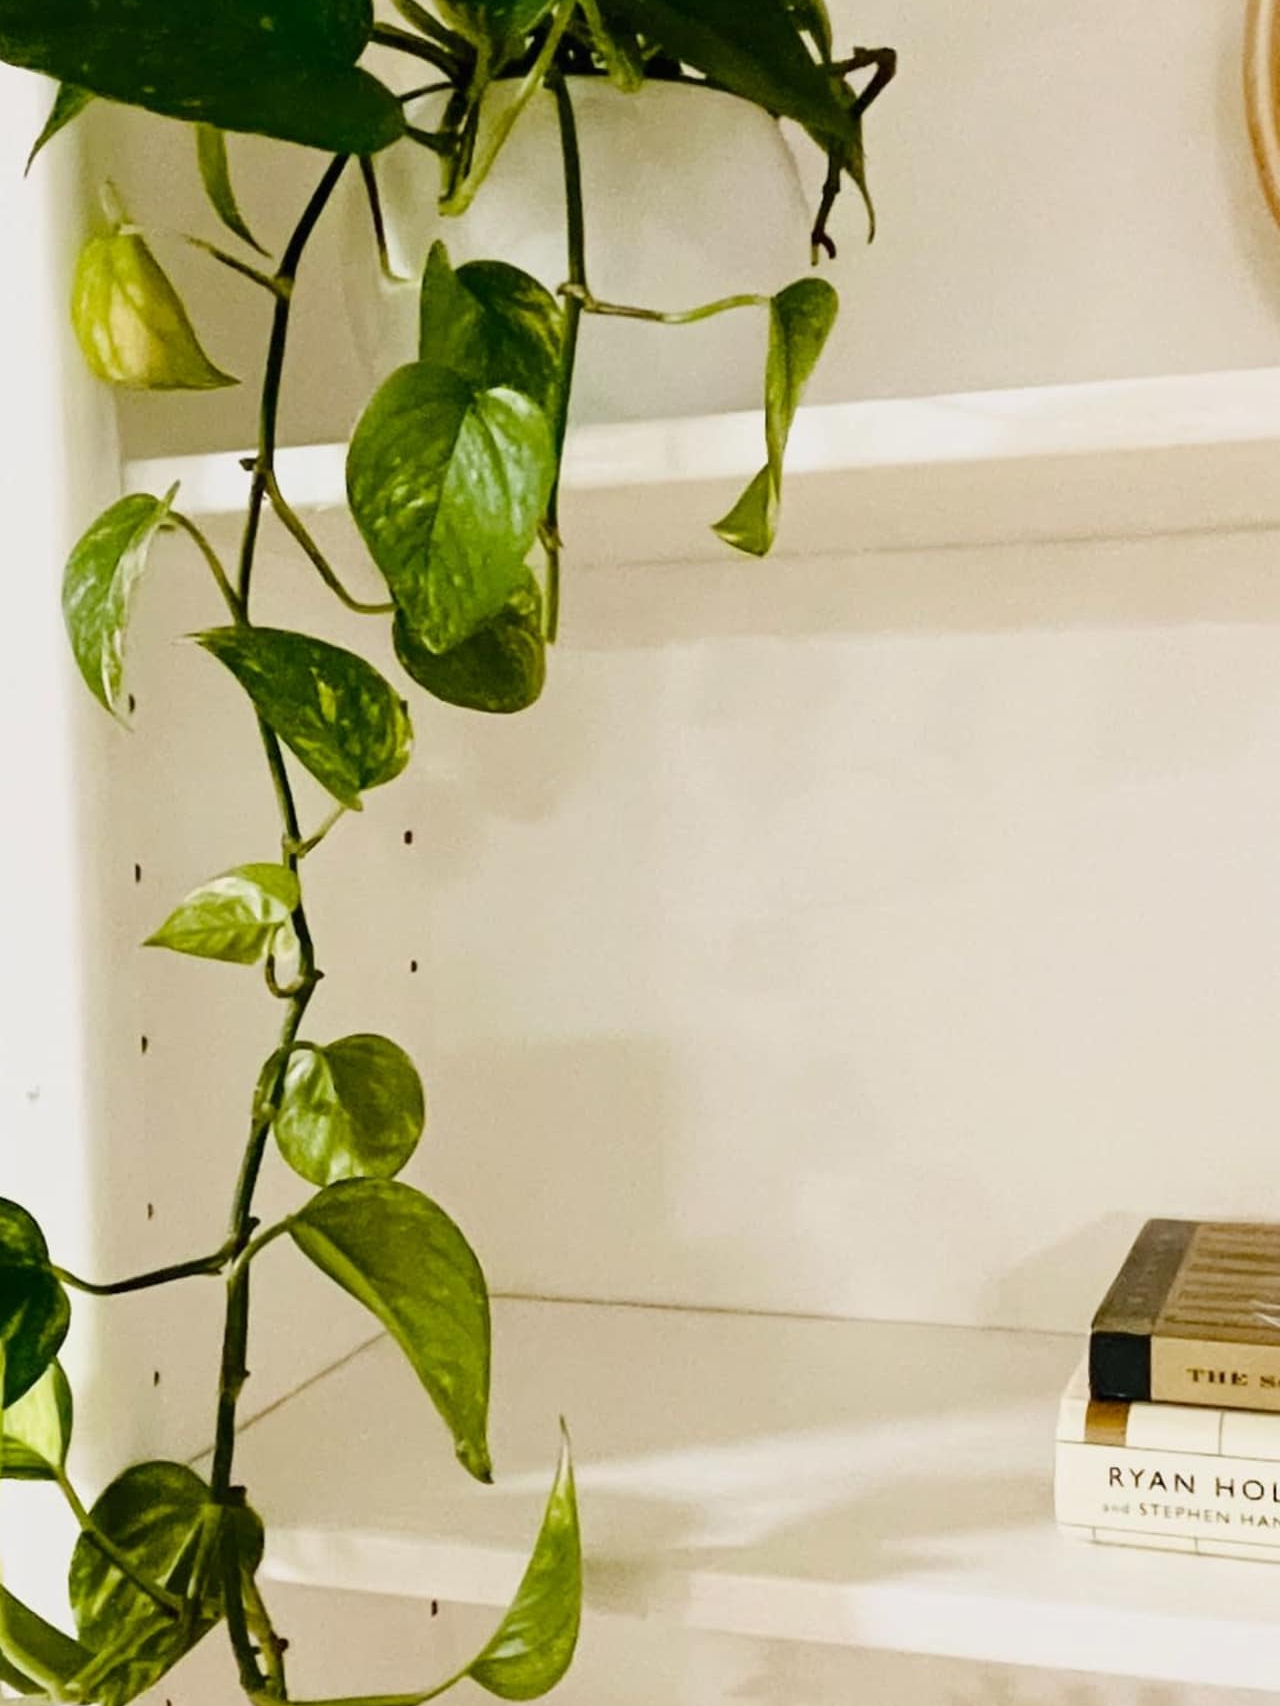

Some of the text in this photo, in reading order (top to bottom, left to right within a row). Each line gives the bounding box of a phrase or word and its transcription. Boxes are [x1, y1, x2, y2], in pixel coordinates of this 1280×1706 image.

[1186, 1368, 1249, 1387] THE
[1108, 1466, 1196, 1495] RYAN
[1138, 1501, 1231, 1526] STEPHEN
